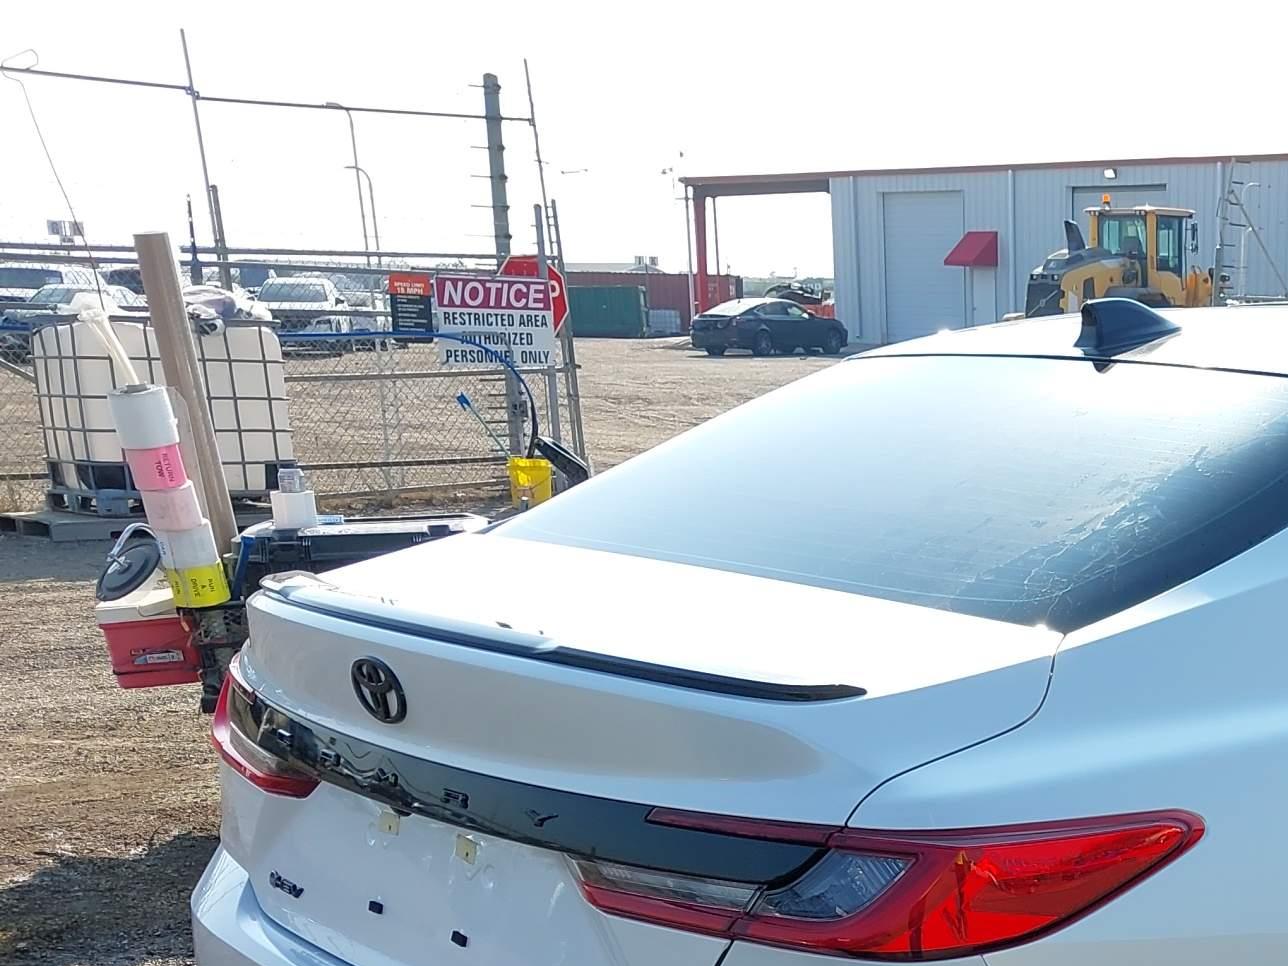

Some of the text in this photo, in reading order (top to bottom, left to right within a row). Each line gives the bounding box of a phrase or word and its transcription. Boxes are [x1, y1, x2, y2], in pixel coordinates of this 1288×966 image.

[407, 287, 424, 295] MPH
[443, 279, 545, 309] NOTICE
[443, 311, 515, 327] RESTRICTED
[518, 313, 549, 328] AREA
[521, 350, 550, 364] ONLY
[155, 461, 165, 478] TOW
